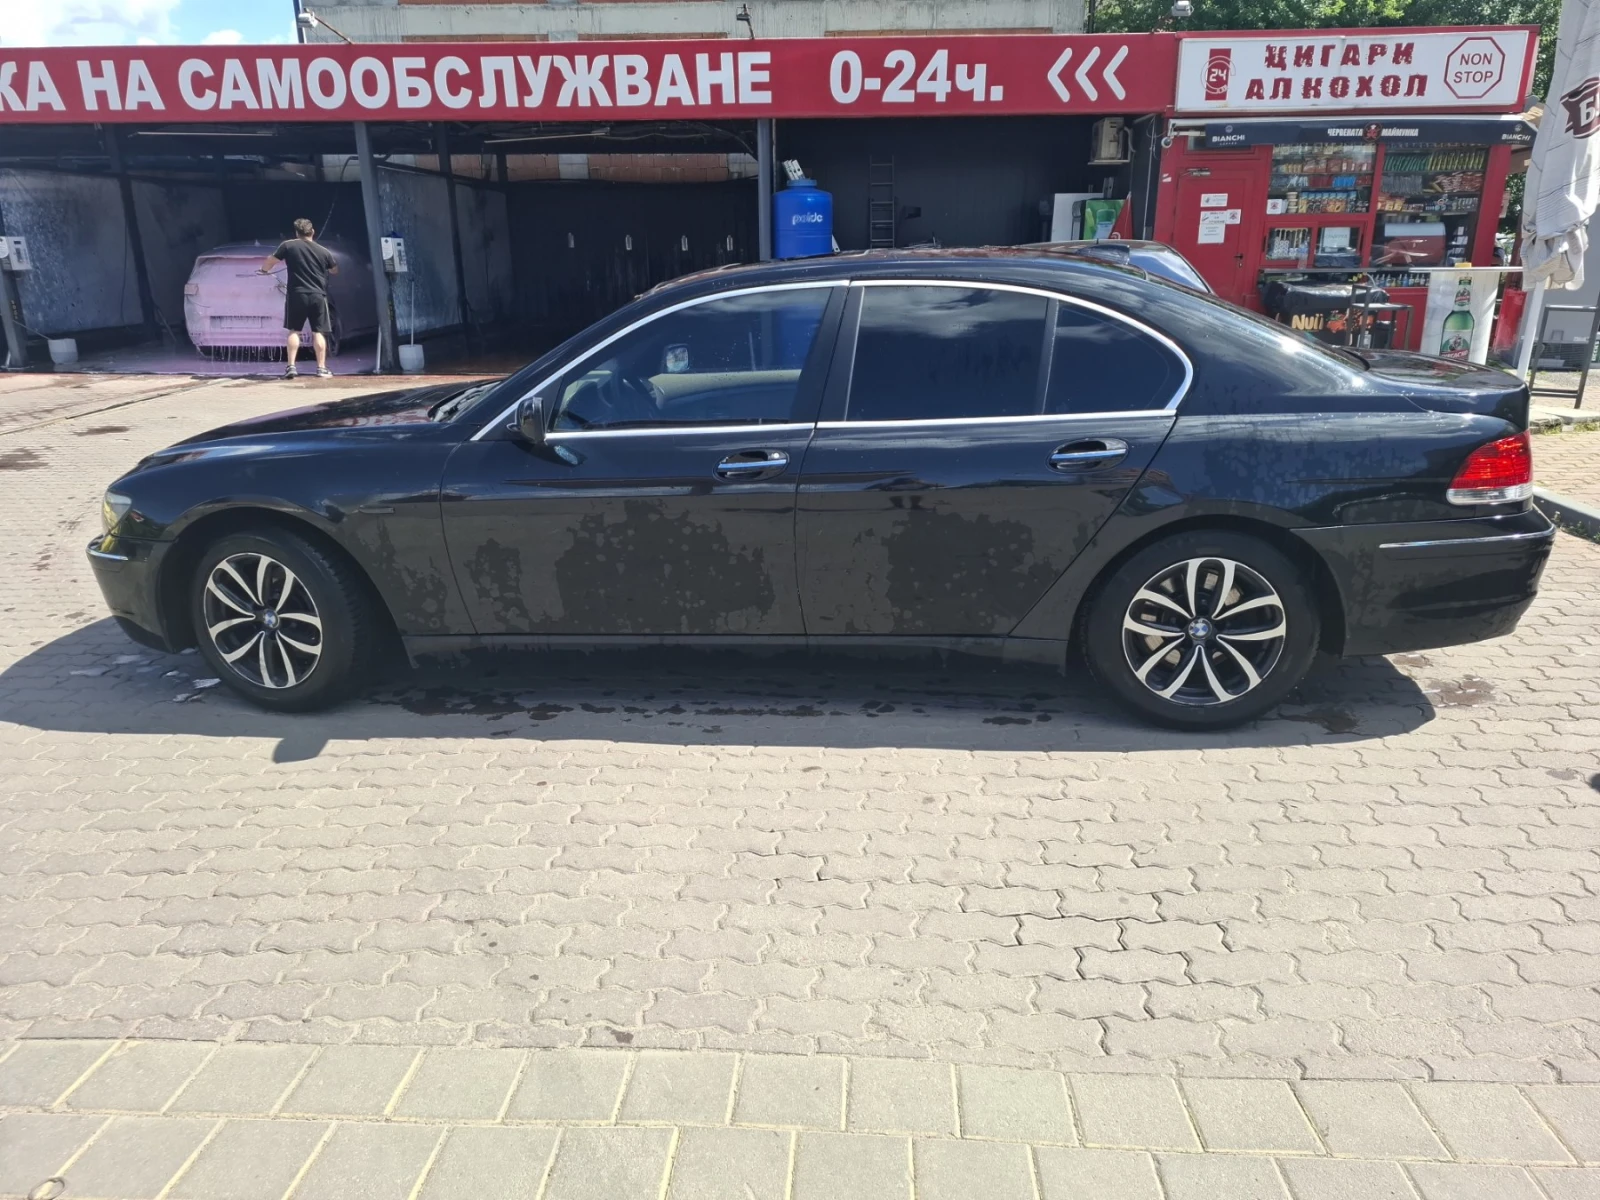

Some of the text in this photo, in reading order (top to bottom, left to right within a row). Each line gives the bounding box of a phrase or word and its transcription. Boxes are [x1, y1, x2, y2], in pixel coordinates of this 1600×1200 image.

[1265, 43, 1415, 71] ЦИГАРИ
[1460, 53, 1493, 66] NON
[0, 50, 1004, 112] КА НА САМООБСЛУЖВАНЕ 0-24ч.
[1209, 68, 1227, 82] 24
[1454, 71, 1495, 84] STOP
[1245, 74, 1428, 101] АЛКОХОЛ
[1327, 126, 1419, 137] ЧЕРВЕНАТА МАЙМУНКА
[1501, 133, 1531, 142] BIANCHI
[1211, 134, 1246, 143] BIANCHI
[1291, 313, 1324, 330] Nuii
